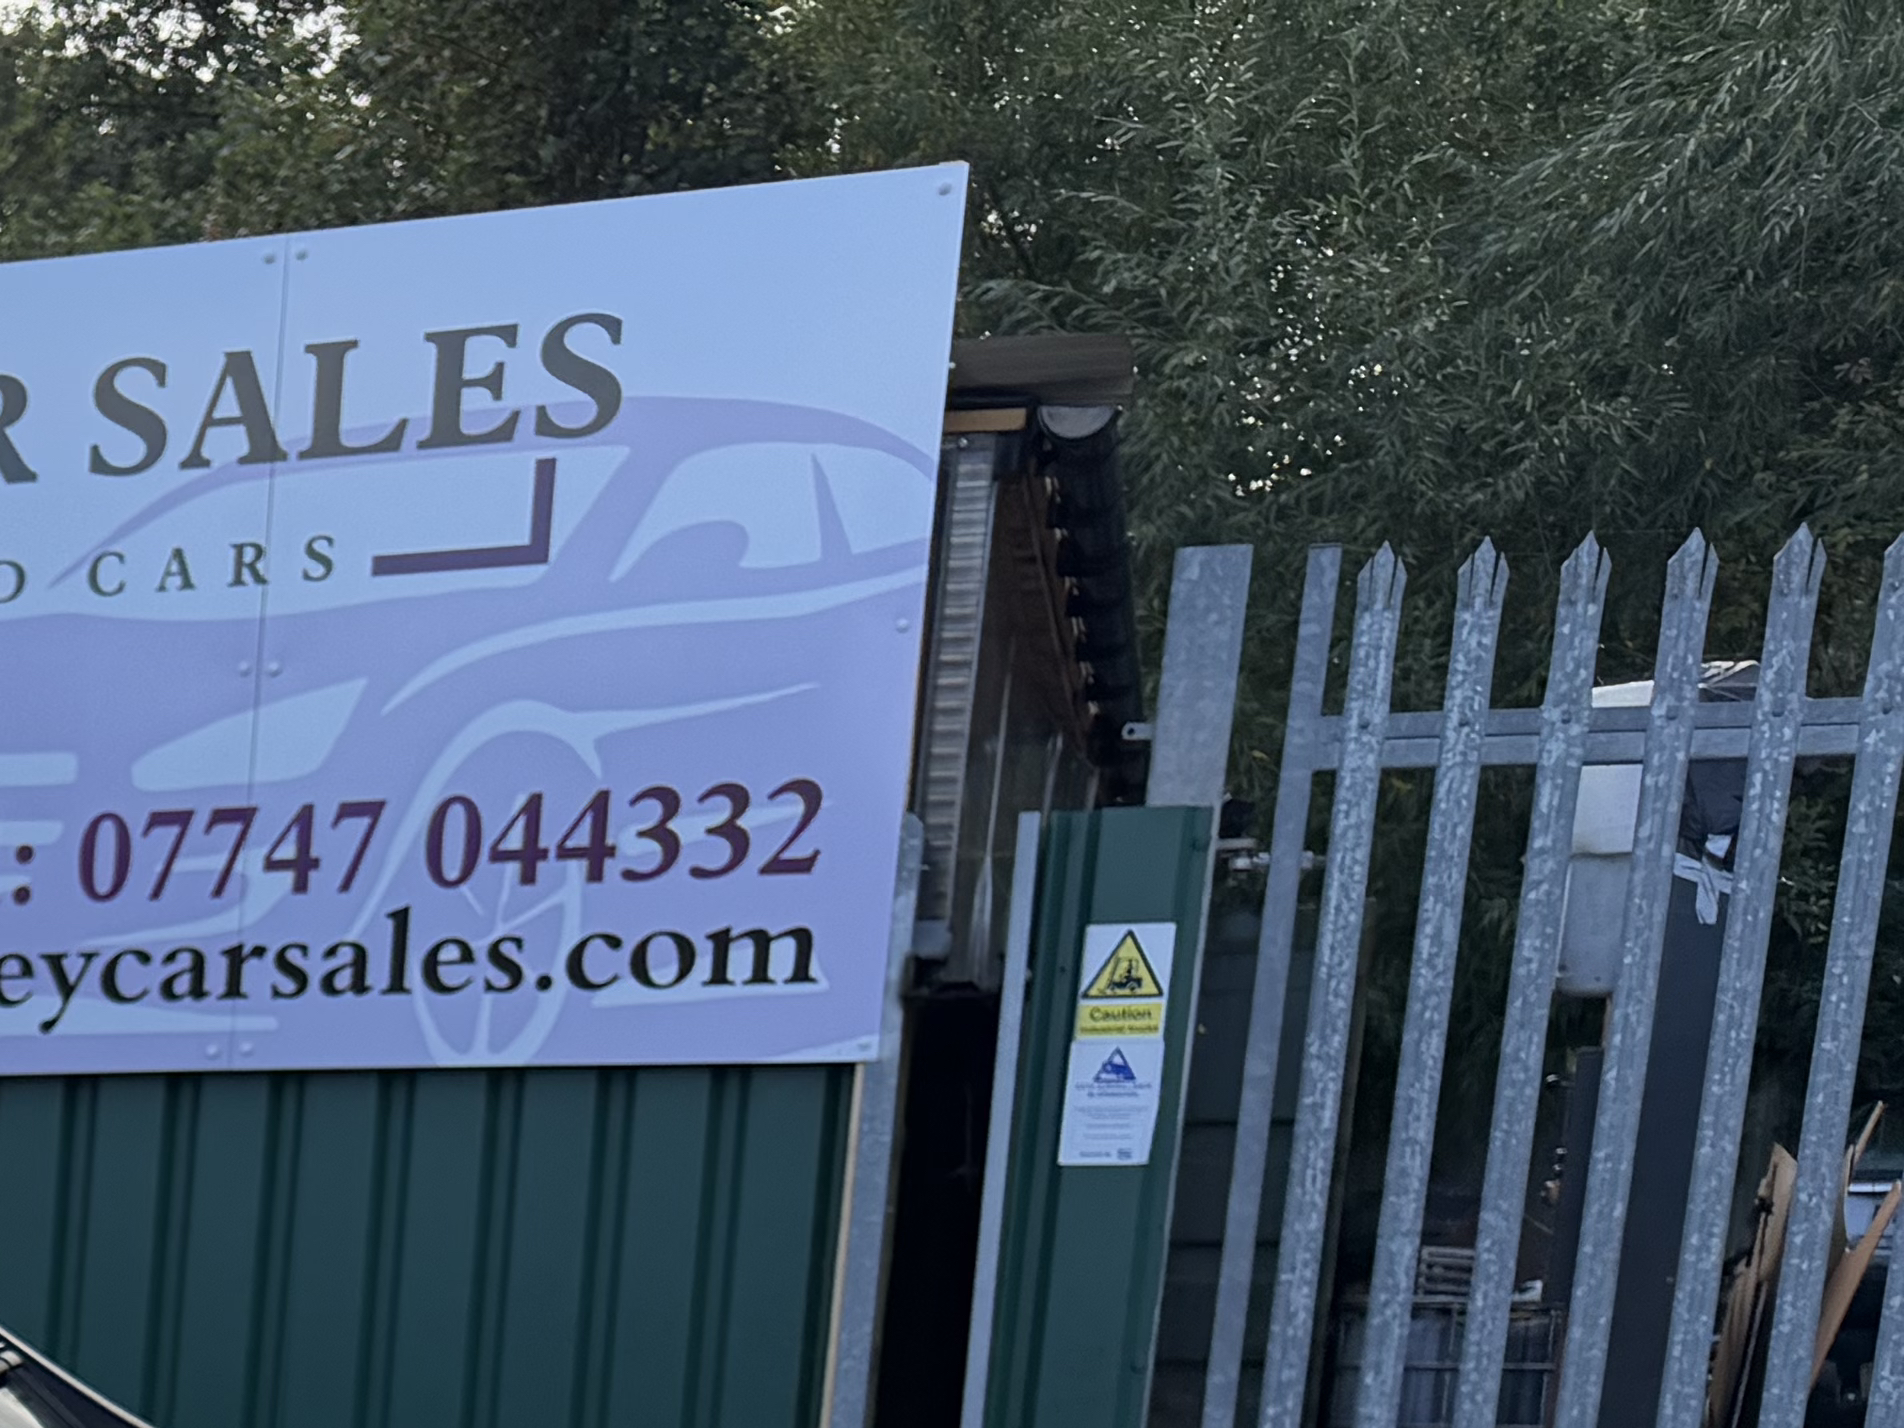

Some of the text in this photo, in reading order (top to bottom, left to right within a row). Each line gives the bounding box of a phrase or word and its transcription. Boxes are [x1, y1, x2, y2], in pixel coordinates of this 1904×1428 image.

[89, 313, 624, 477] SALES
[87, 535, 334, 598] CARS
[78, 800, 387, 903] 07747
[425, 779, 824, 889] 044332
[1089, 1007, 1152, 1022] Caution
